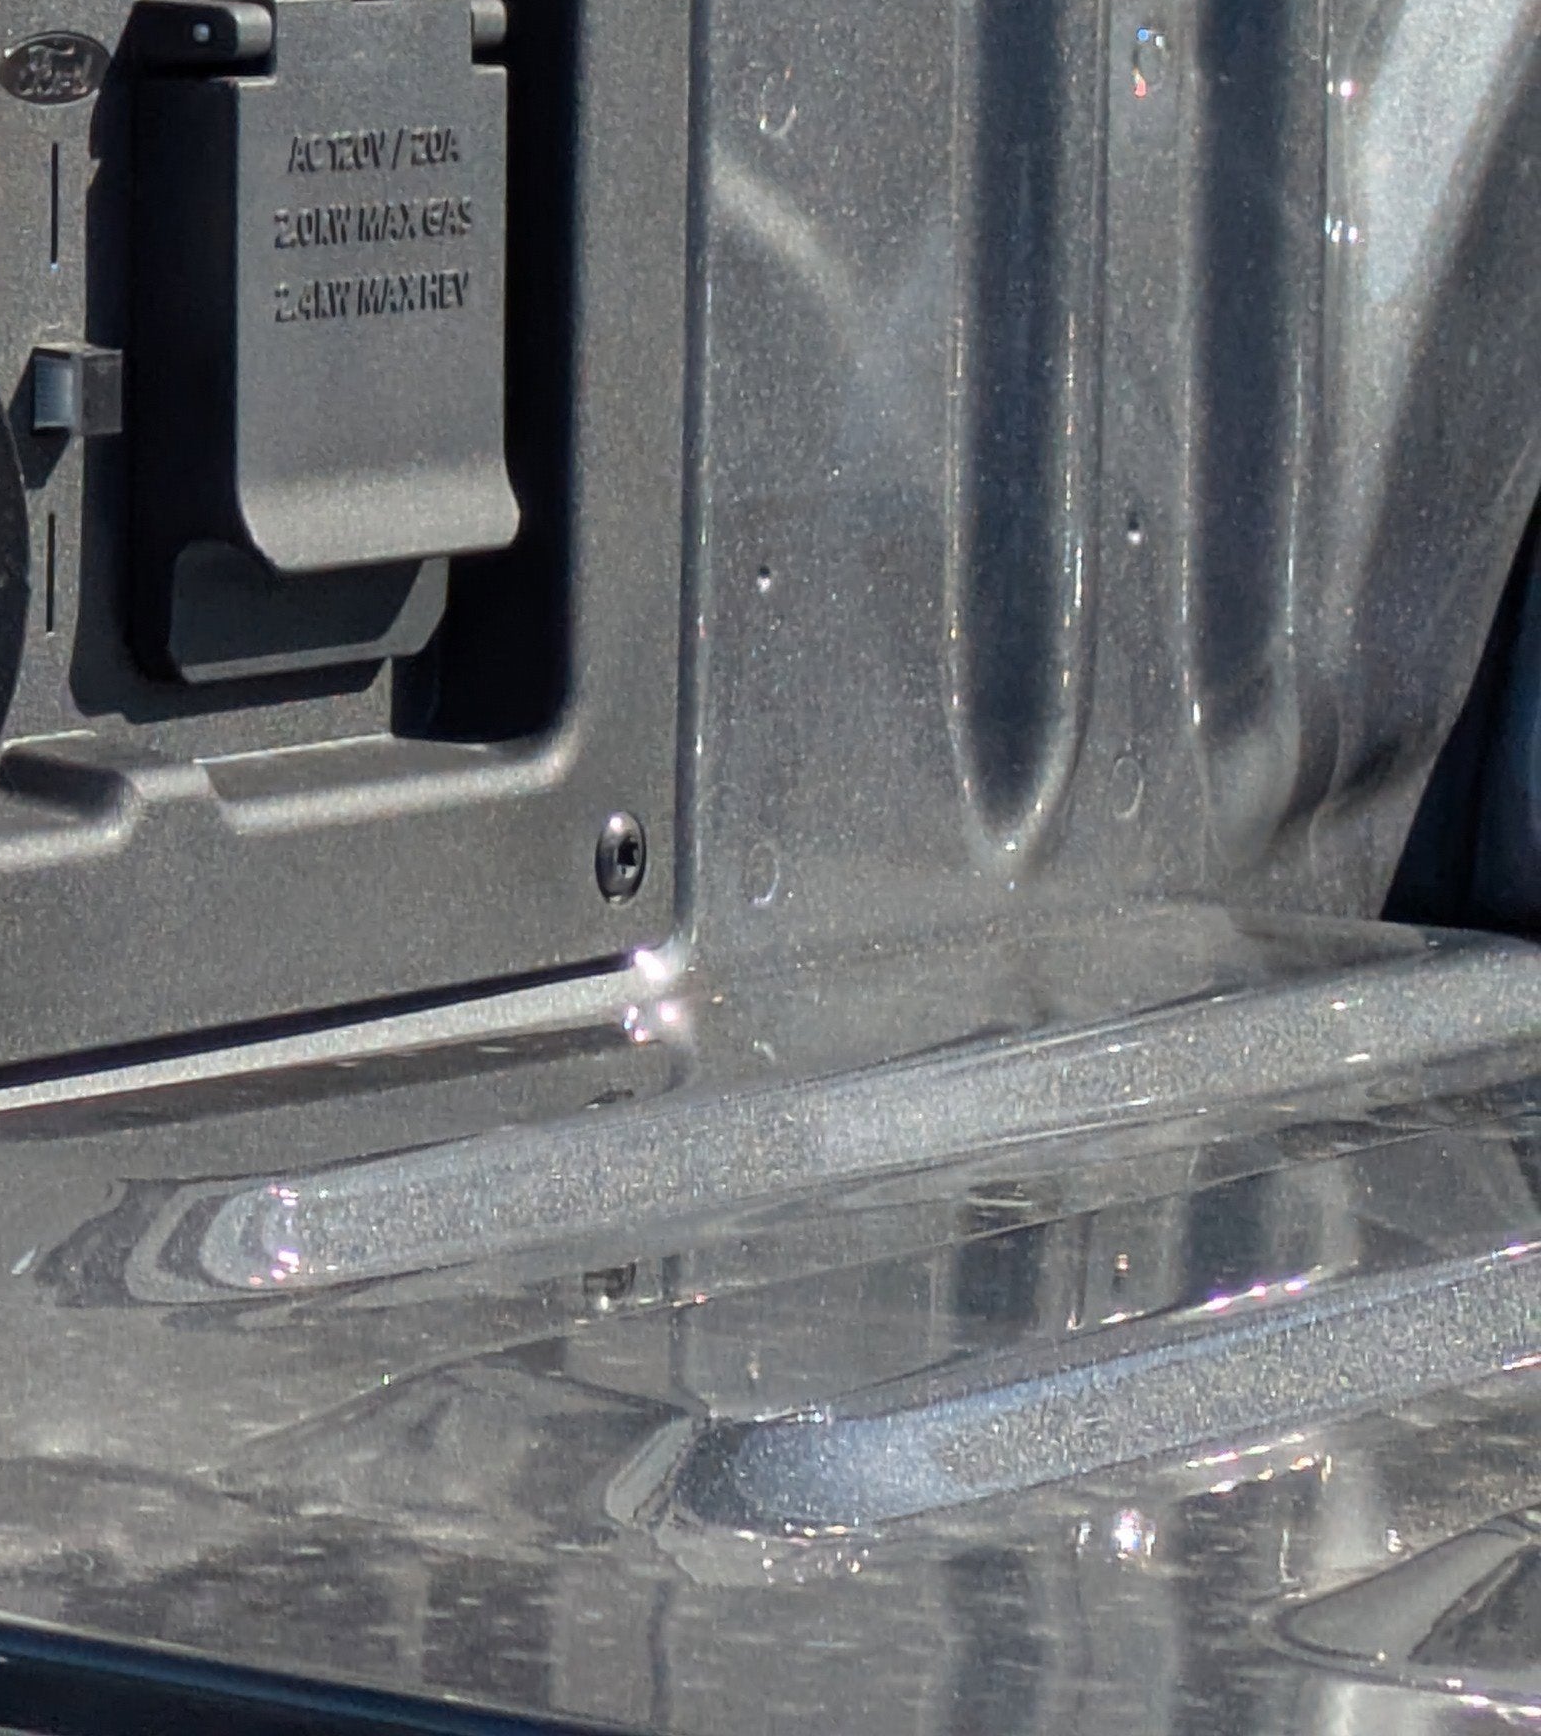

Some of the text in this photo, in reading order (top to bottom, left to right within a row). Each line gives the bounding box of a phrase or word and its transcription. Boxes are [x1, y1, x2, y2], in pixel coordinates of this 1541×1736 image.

[288, 133, 322, 173] AC
[327, 128, 387, 172] 120V
[411, 125, 460, 166] 20A
[357, 201, 417, 243] MAX
[421, 196, 472, 238] GAS
[357, 274, 416, 317] MAX
[420, 269, 470, 311] HEV
